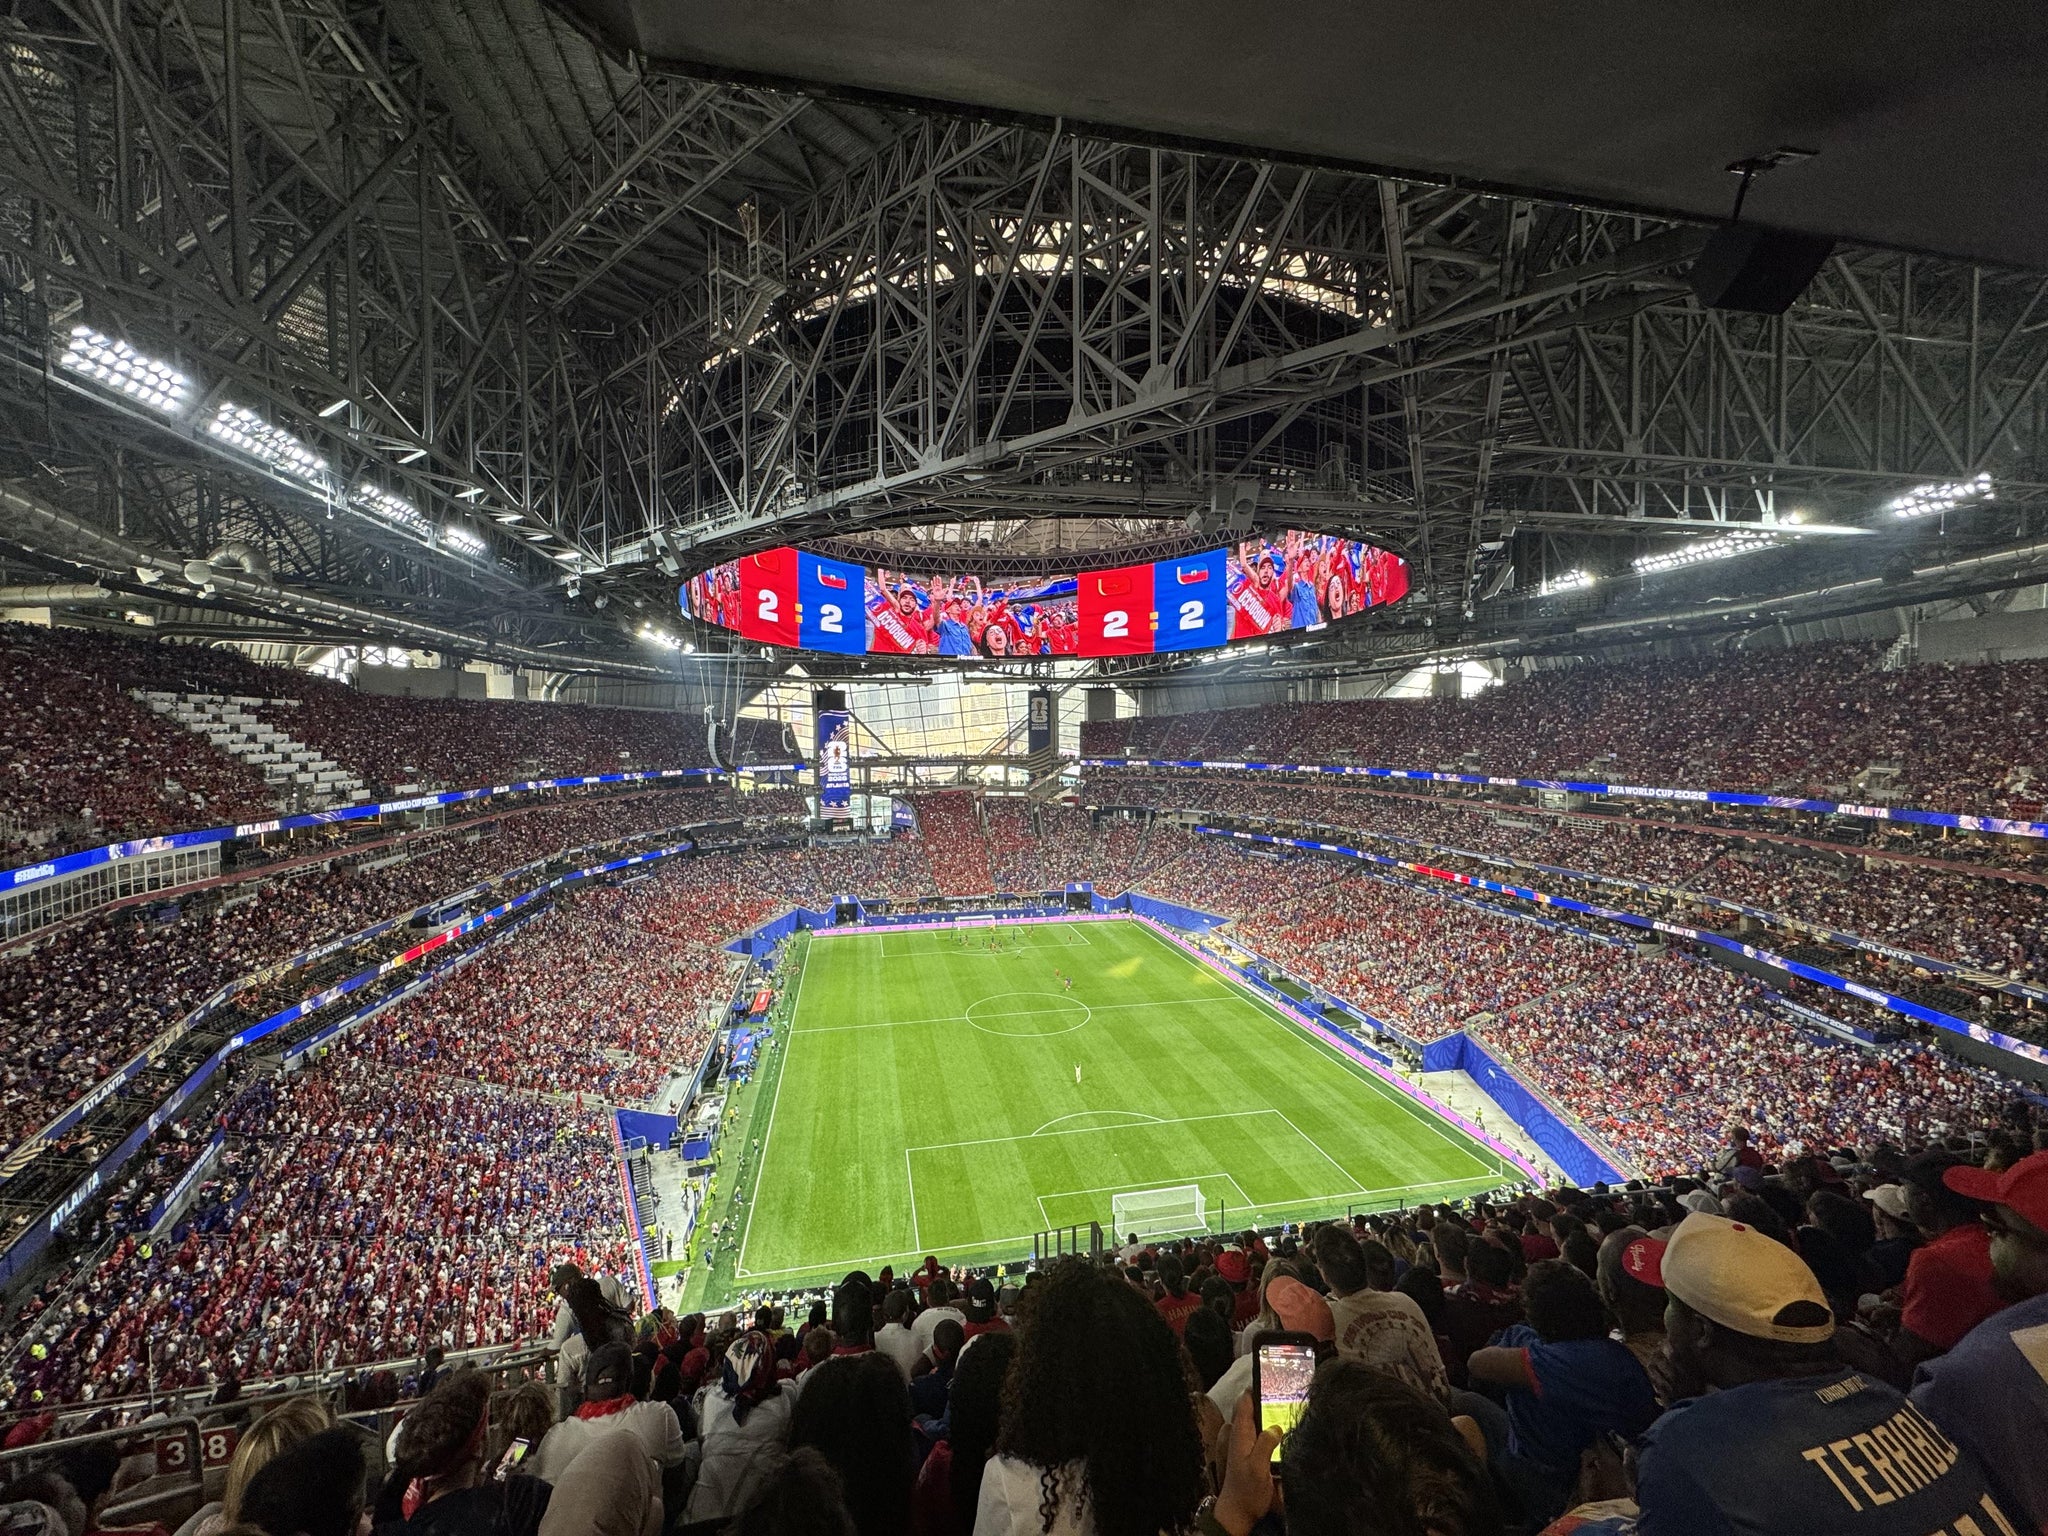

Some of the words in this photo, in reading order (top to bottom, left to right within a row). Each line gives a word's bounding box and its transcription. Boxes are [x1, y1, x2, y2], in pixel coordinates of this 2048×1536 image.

[758, 588, 779, 623] 2
[820, 603, 843, 634] 2
[1103, 610, 1129, 638] 2
[1179, 600, 1204, 630] 2
[876, 610, 915, 649] MOROCCO
[1607, 785, 1624, 794] FIFA
[1625, 786, 1655, 796] WORLD
[1656, 788, 1673, 798] CUP
[1674, 790, 1708, 801] 2026
[1837, 803, 1889, 819] ATLANTA
[235, 819, 280, 837] ATLANTA
[1454, 873, 1462, 882] 2
[1479, 880, 1487, 888] 2
[1601, 876, 1640, 889] ATLANTA
[465, 921, 474, 930] 2
[1652, 920, 1697, 939] ATLANTA
[446, 930, 453, 941] 2
[306, 941, 344, 961] ATLANTA
[1857, 941, 1914, 963] ATLANTA
[82, 1073, 126, 1115] ATLANTA
[50, 1171, 100, 1232] ATLANTA
[166, 1434, 227, 1466] 38
